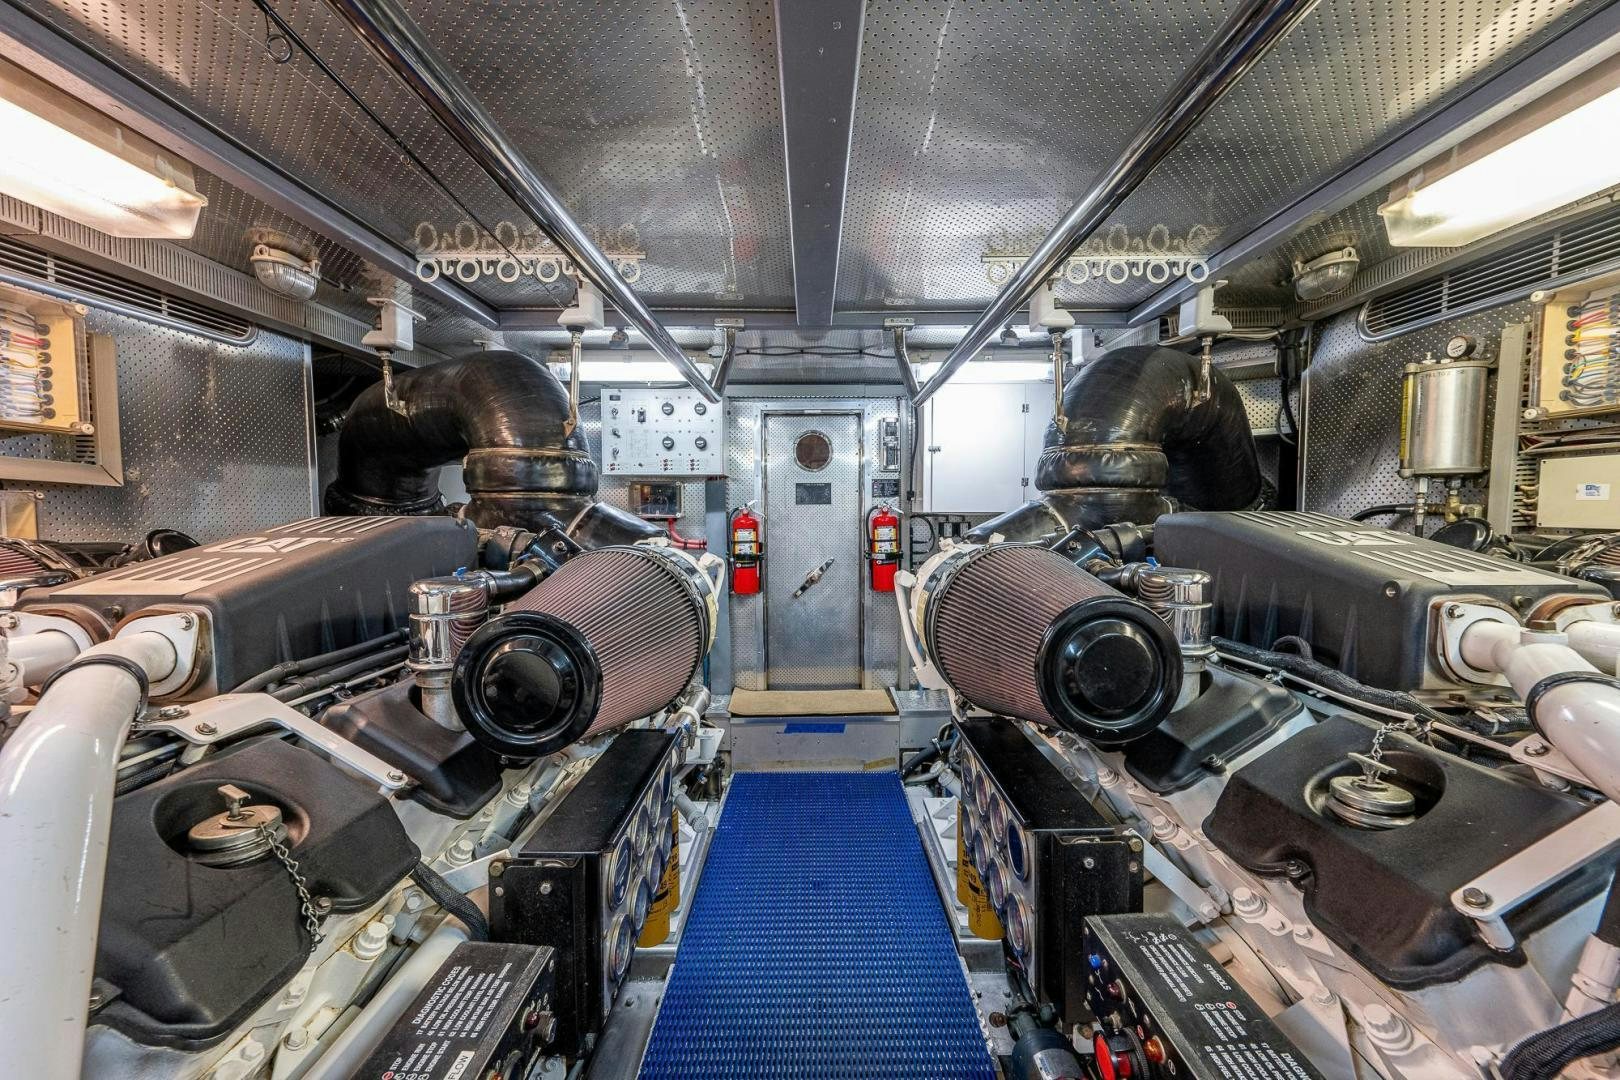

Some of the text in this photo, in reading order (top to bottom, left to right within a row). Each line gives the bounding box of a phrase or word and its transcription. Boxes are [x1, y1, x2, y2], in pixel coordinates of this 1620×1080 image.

[202, 537, 335, 553] CAT
[1296, 530, 1417, 546] CAT
[1203, 963, 1232, 990] SYMBOLS
[411, 966, 461, 1024] DIAGNOSTIC CODES
[1233, 1009, 1247, 1021] STOP
[425, 1041, 438, 1054] STOP
[1232, 1051, 1246, 1064] LOW
[1255, 1050, 1269, 1062] LOW
[389, 1057, 403, 1071] STOP
[448, 1055, 470, 1080] FLOW
